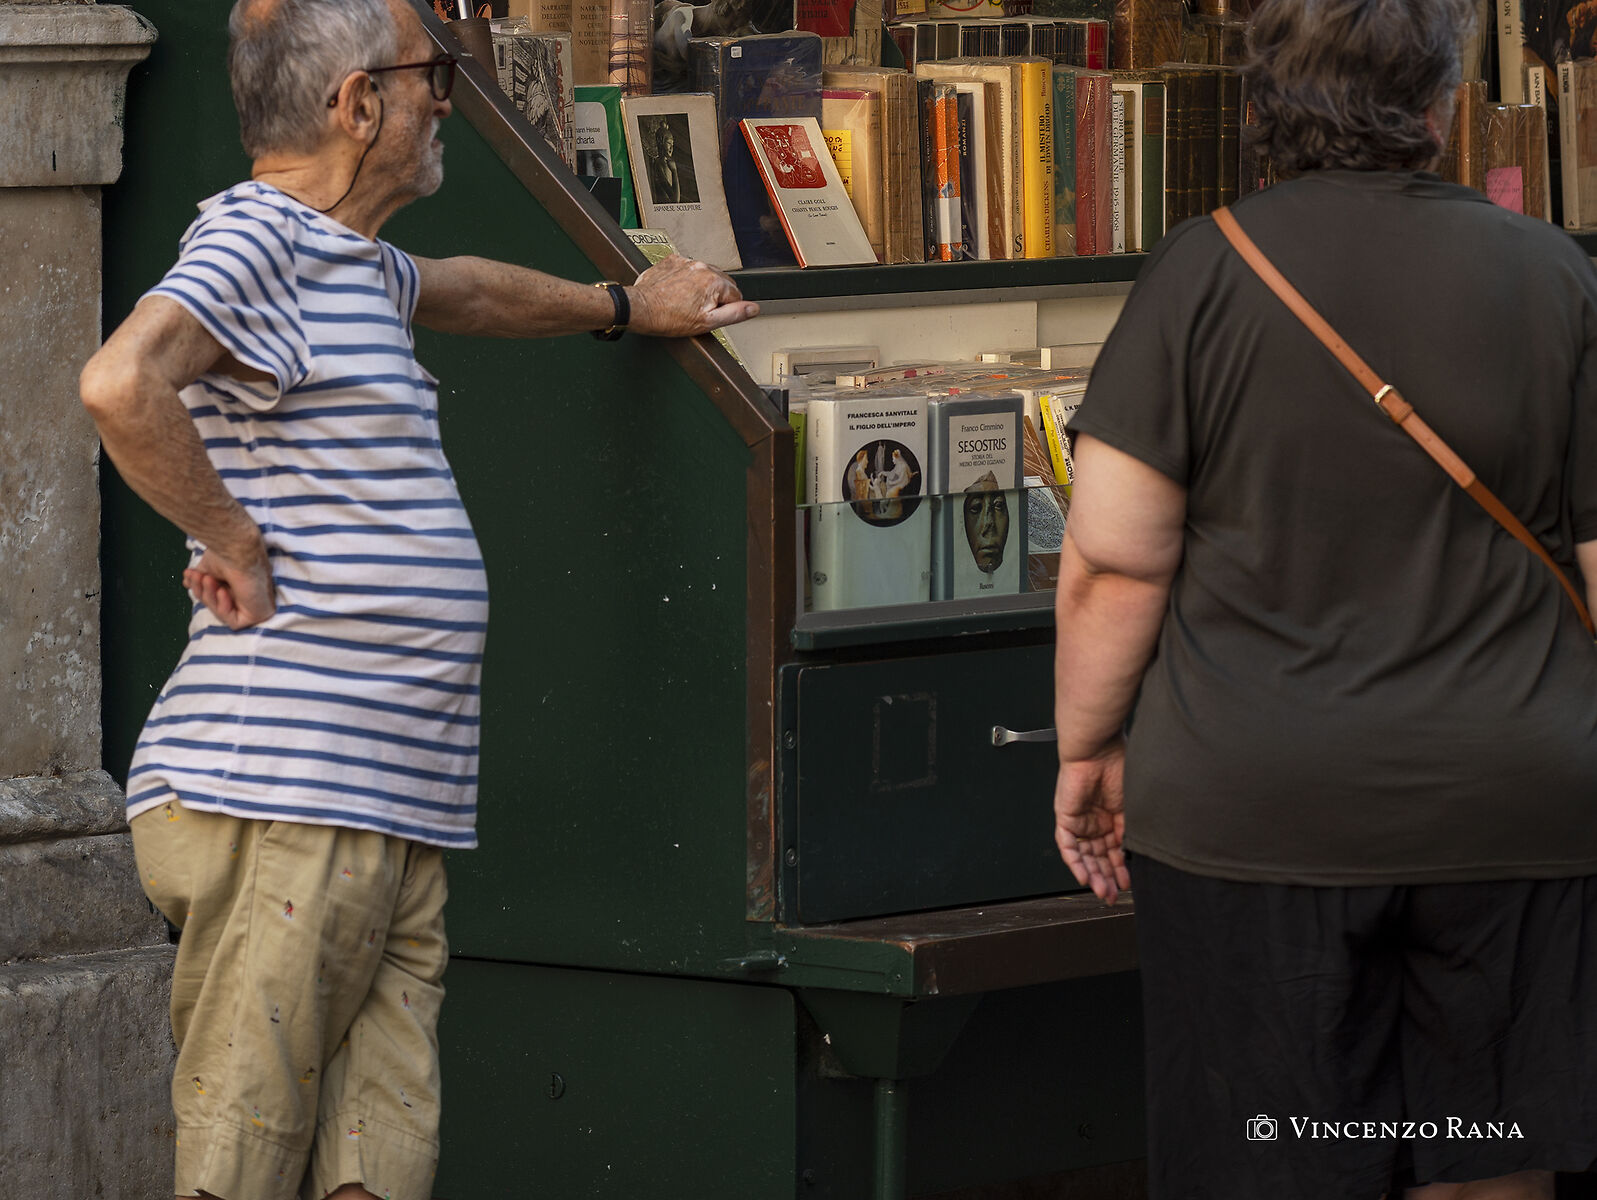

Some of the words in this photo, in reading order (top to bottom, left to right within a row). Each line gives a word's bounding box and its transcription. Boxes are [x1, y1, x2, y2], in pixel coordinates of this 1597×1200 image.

[1505, 24, 1512, 36] LE
[576, 136, 594, 145] dharta
[1045, 165, 1051, 175] DI
[848, 411, 884, 419] FRANCESCA
[980, 423, 1004, 431] Cimmino
[958, 438, 1007, 453] SESOSTRIS
